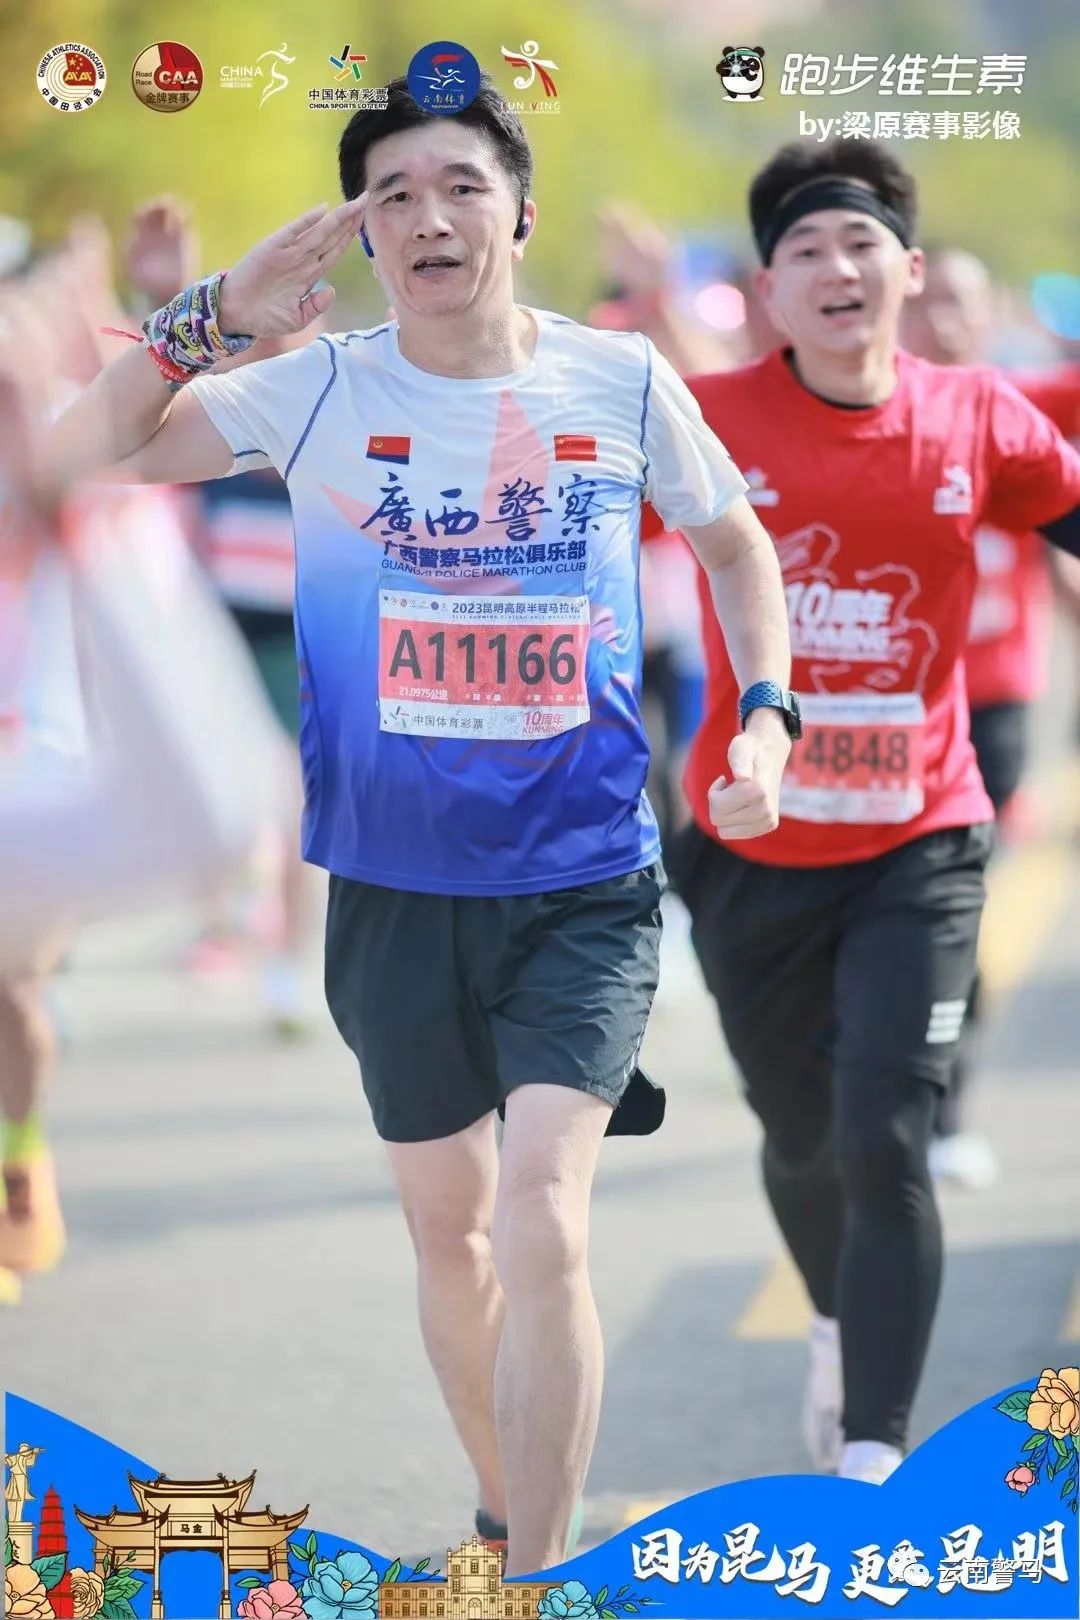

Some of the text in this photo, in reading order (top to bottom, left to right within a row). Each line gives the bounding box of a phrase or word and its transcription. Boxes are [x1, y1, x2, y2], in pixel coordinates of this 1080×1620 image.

[383, 540, 587, 568] 广西警察马拉松俱乐部
[435, 568, 480, 578] POLICE
[482, 565, 553, 578] MARATHON
[555, 562, 587, 573] CLUB
[452, 602, 584, 615] 2023昆明高原半程马拉松
[388, 628, 577, 686] A11166
[399, 686, 449, 701] 21.0975公里
[413, 714, 484, 729] 中国体育彩票
[524, 710, 565, 726] 10周年
[522, 724, 565, 734] KUNMING
